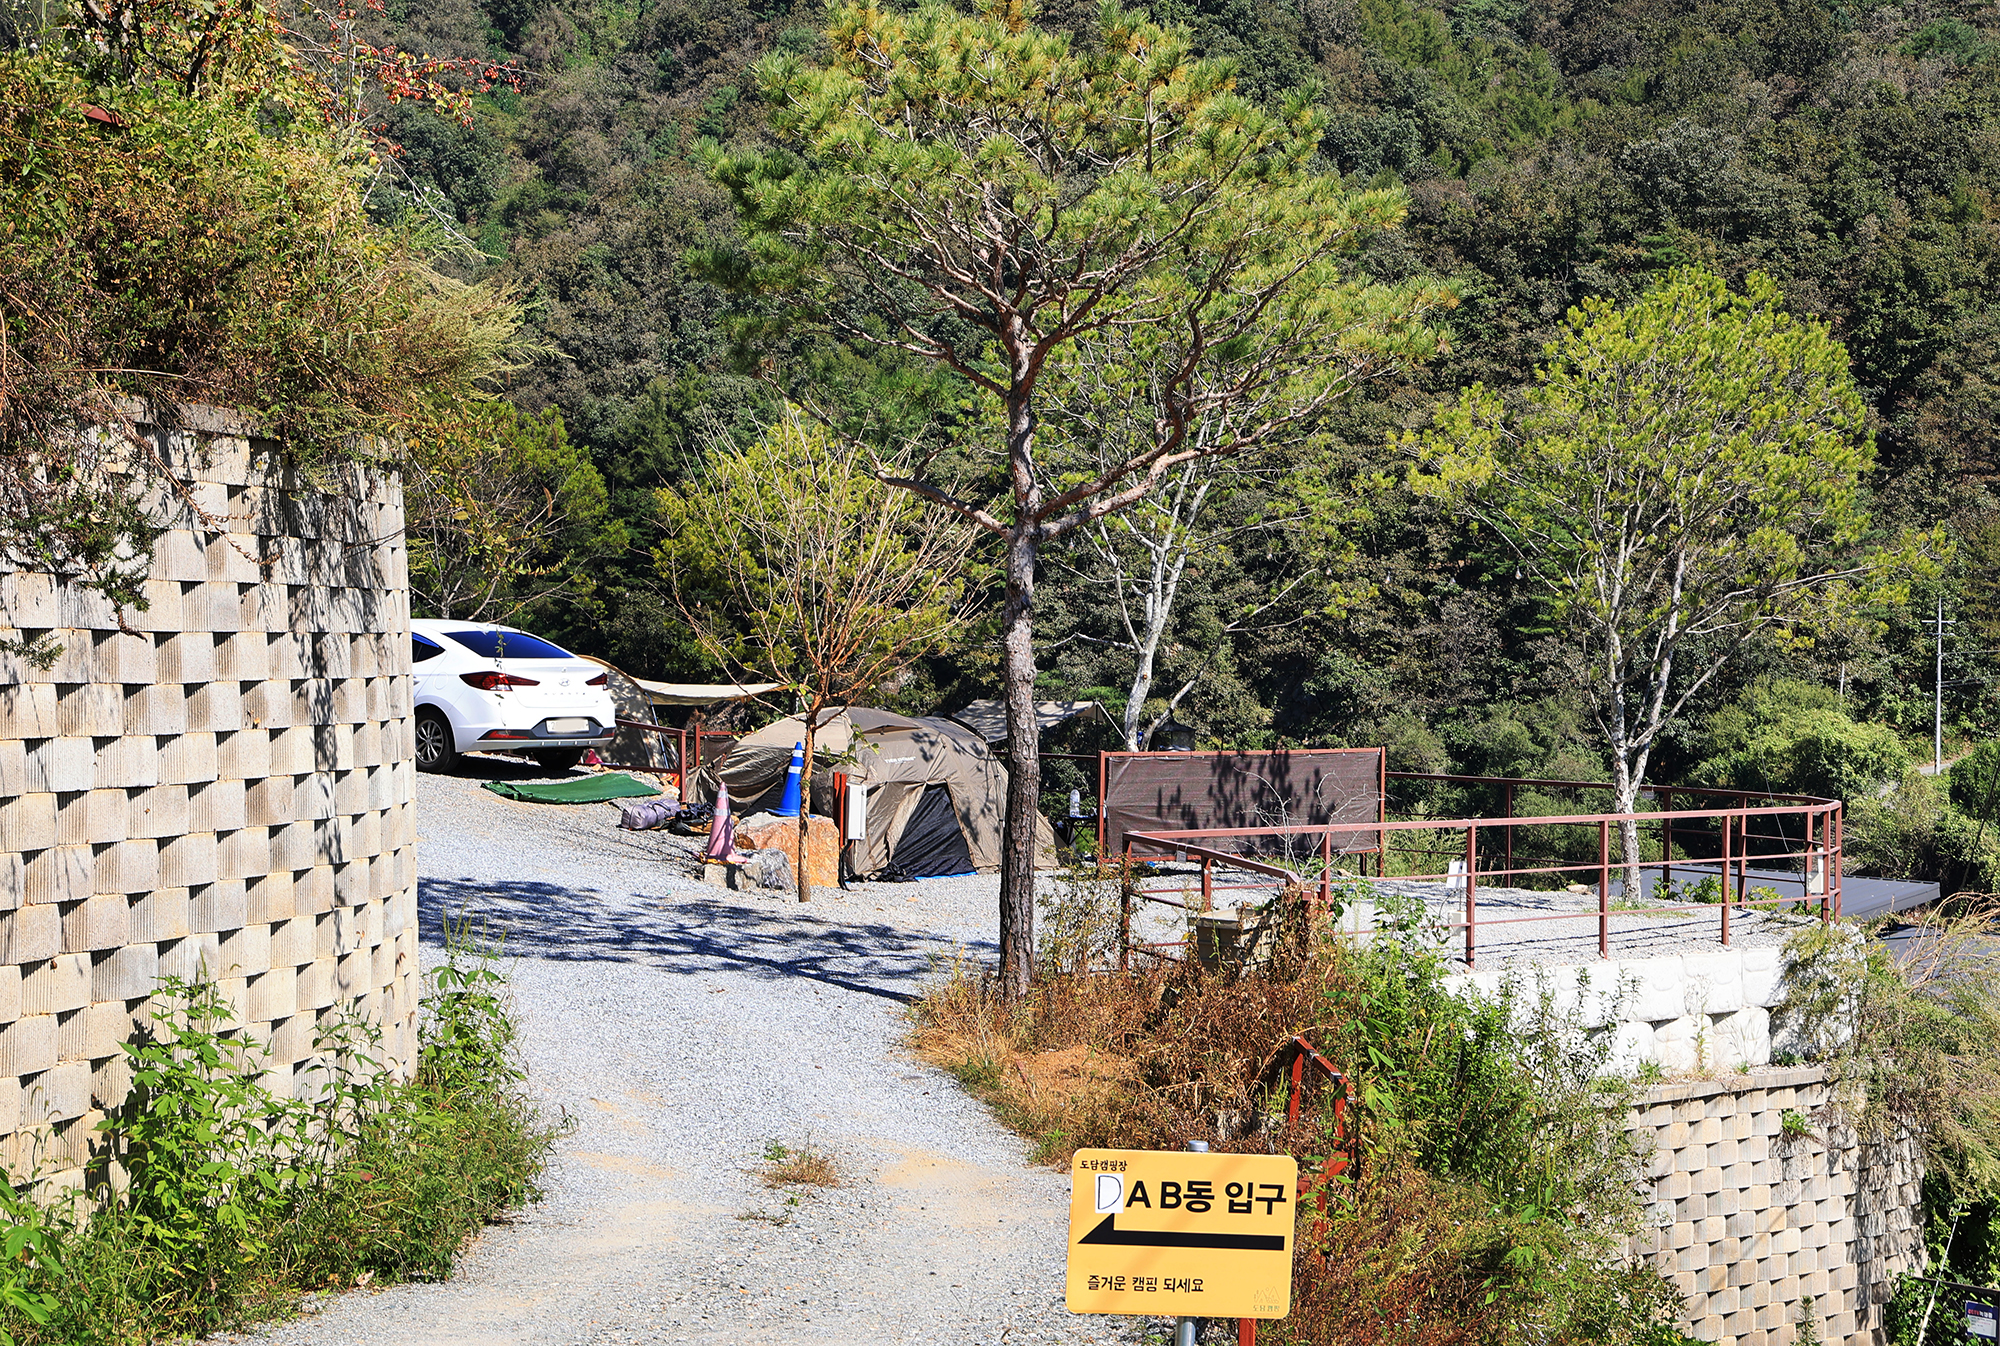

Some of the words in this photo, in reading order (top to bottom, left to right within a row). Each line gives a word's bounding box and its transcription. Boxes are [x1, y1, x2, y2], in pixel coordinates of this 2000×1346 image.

[1079, 1159, 1128, 1172] 도담캠핑장
[1160, 1180, 1215, 1213] B동
[1225, 1182, 1287, 1215] 입구
[1087, 1274, 1127, 1292] 즐거운
[1131, 1276, 1158, 1293] 캠핑
[1162, 1277, 1205, 1294] 되세요
